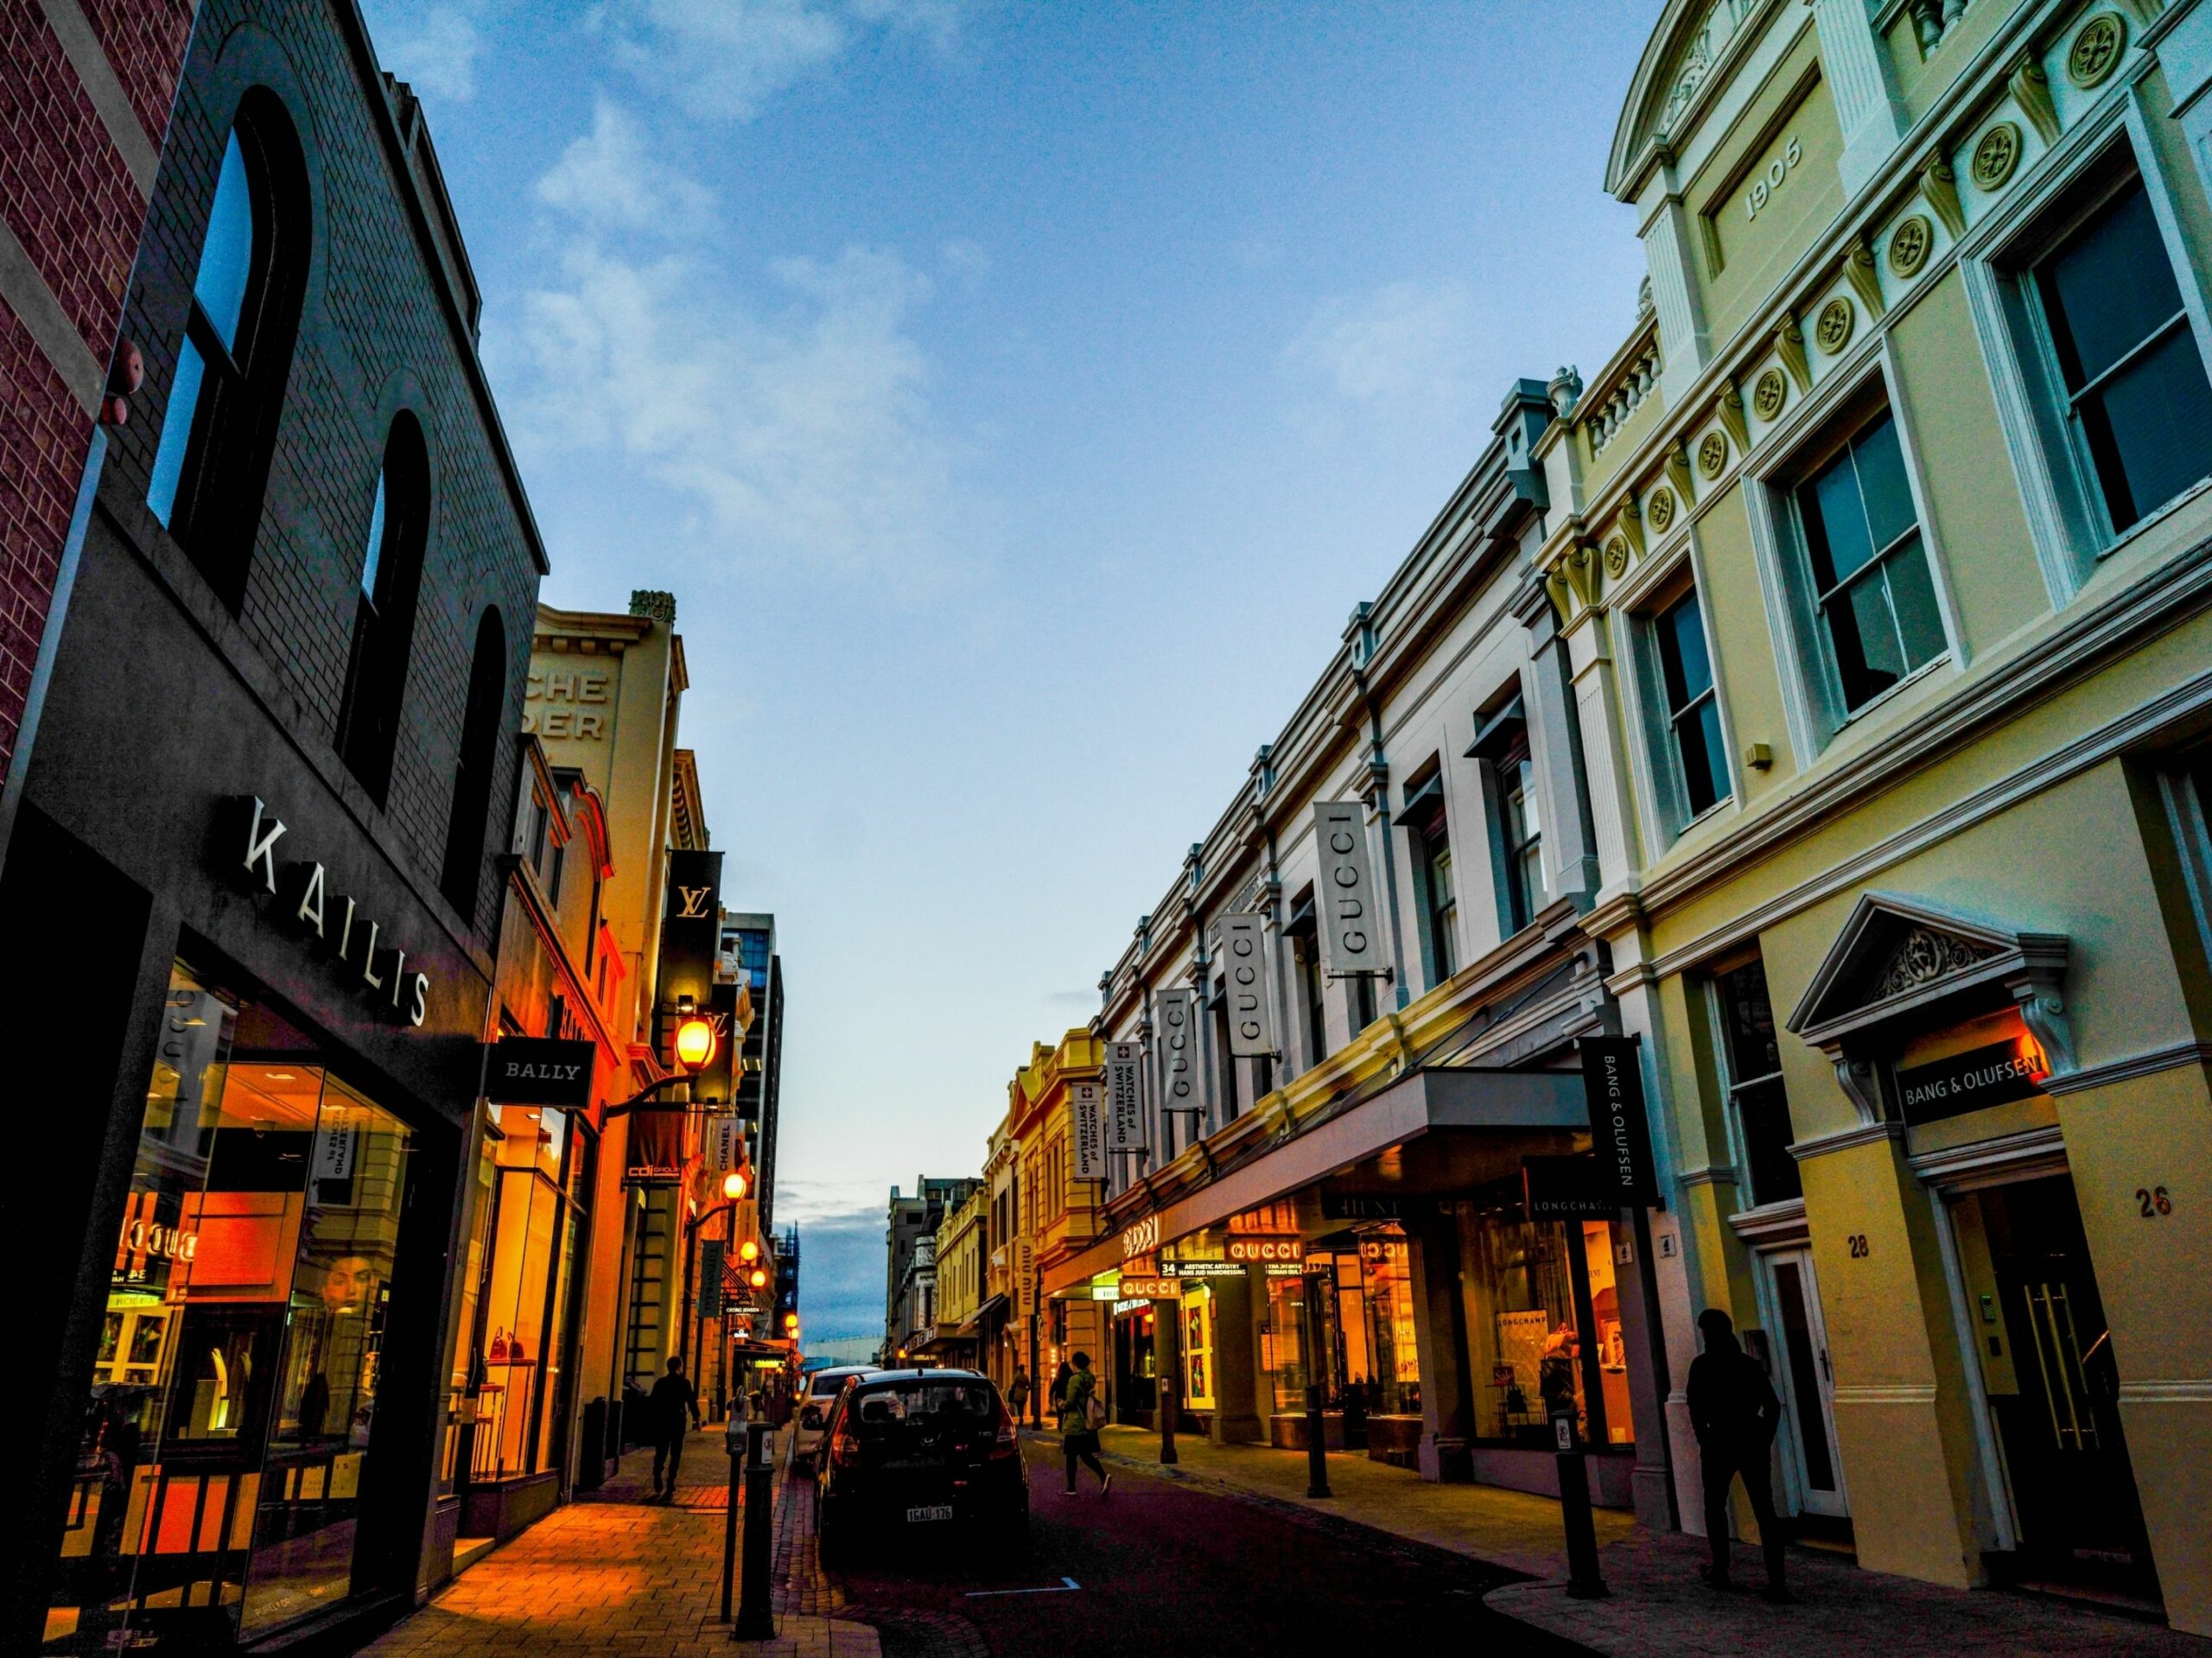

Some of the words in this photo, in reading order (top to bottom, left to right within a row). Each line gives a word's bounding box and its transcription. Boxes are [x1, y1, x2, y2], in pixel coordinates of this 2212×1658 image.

[1745, 136, 1802, 222] 1905
[1328, 816, 1367, 954] GUCCI
[243, 795, 429, 1026] KAILIS
[1232, 925, 1261, 1040] GUCCI
[505, 1061, 582, 1081] BALLY
[1166, 999, 1190, 1098] GUCCI
[1126, 1065, 1136, 1118] WATCHES
[1604, 1055, 1620, 1097] BANG
[1905, 1080, 1947, 1105] BANG
[1951, 1078, 1961, 1094] &
[1963, 1055, 2040, 1089] OLUFSEN
[1089, 1104, 1097, 1150] WATCHES
[1115, 1065, 1126, 1144] SWITZERLAND
[1128, 1118, 1136, 1129] of
[1611, 1102, 1622, 1112] &
[720, 1125, 730, 1172] CHANEL
[1078, 1105, 1089, 1174] SWITZERLAND
[1090, 1151, 1098, 1162] of
[1612, 1116, 1633, 1186] OLUFSEN
[2135, 1185, 2171, 1217] 26
[1162, 1263, 1176, 1274] 34
[1230, 1242, 1300, 1260] GUCCI
[1847, 1234, 1869, 1259] 28
[1123, 1282, 1176, 1295] GUCCI
